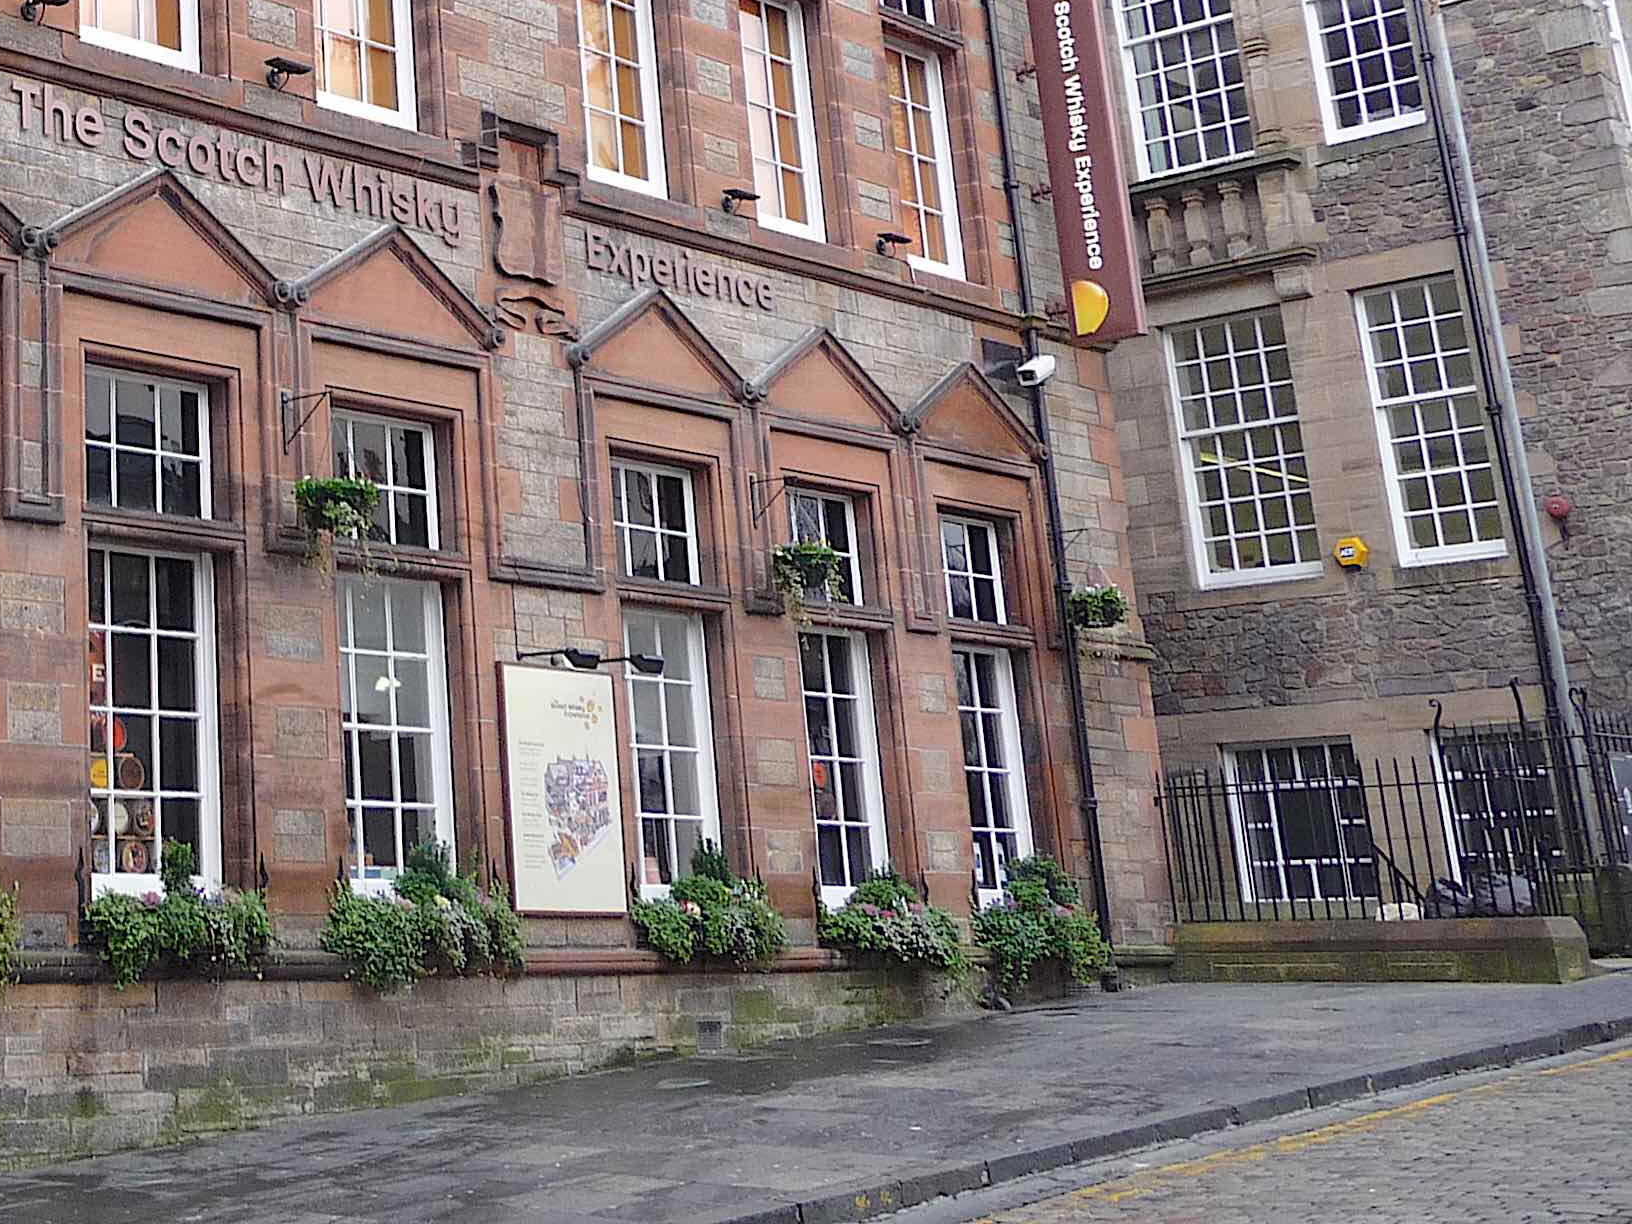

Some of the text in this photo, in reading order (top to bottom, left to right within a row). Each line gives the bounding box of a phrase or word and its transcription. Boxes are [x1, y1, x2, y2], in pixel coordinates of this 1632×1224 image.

[1054, 1, 1079, 73] Scotch
[1064, 74, 1088, 153] Whisky
[11, 80, 777, 312] The Scotch Whisky Experience
[1073, 155, 1104, 271] Experience
